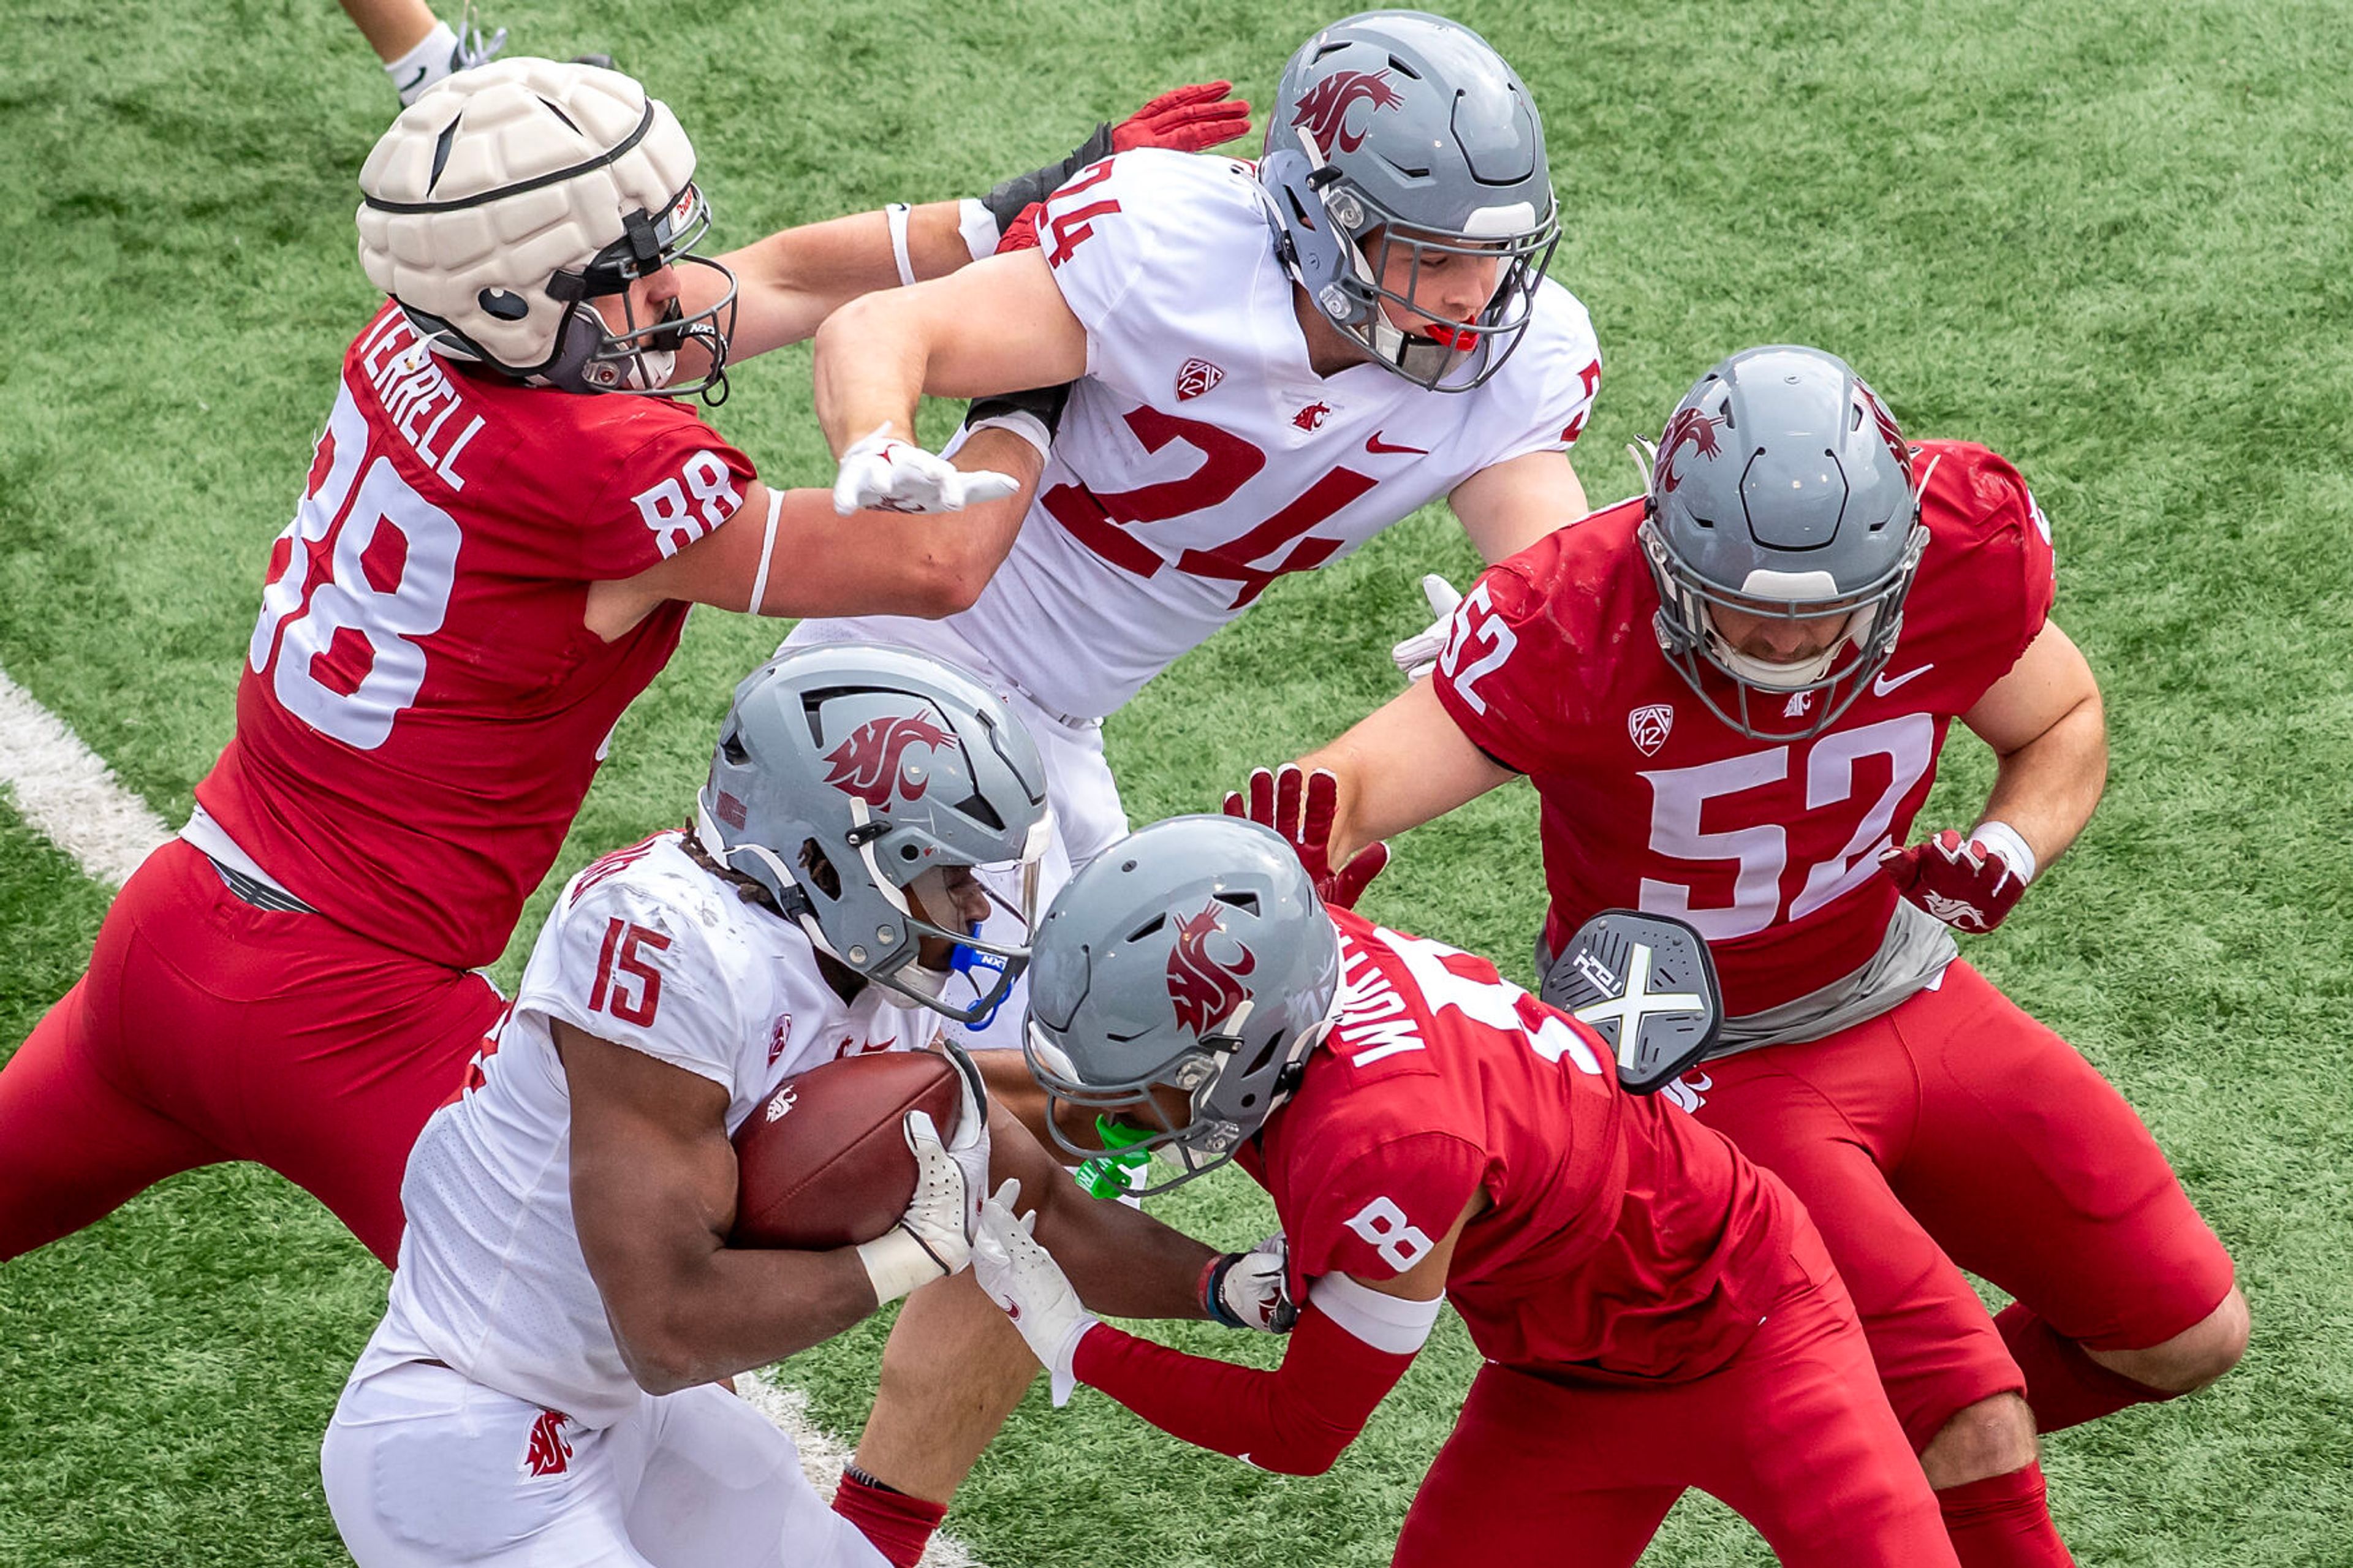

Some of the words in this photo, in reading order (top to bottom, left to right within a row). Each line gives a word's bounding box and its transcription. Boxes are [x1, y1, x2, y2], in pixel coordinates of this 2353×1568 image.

[1039, 157, 1121, 269] 24
[360, 305, 487, 492] TERRELL
[1178, 377, 1205, 396] 12
[1180, 360, 1223, 392] PAC
[631, 450, 743, 560] 88
[1040, 404, 1379, 610] 24
[250, 378, 463, 750] 88
[1440, 579, 1518, 716] 52
[1632, 707, 1671, 737] PAC
[1640, 727, 1661, 746] 12
[1636, 713, 1934, 941] 52
[588, 917, 672, 1028] 15
[1344, 1196, 1435, 1273] 8
